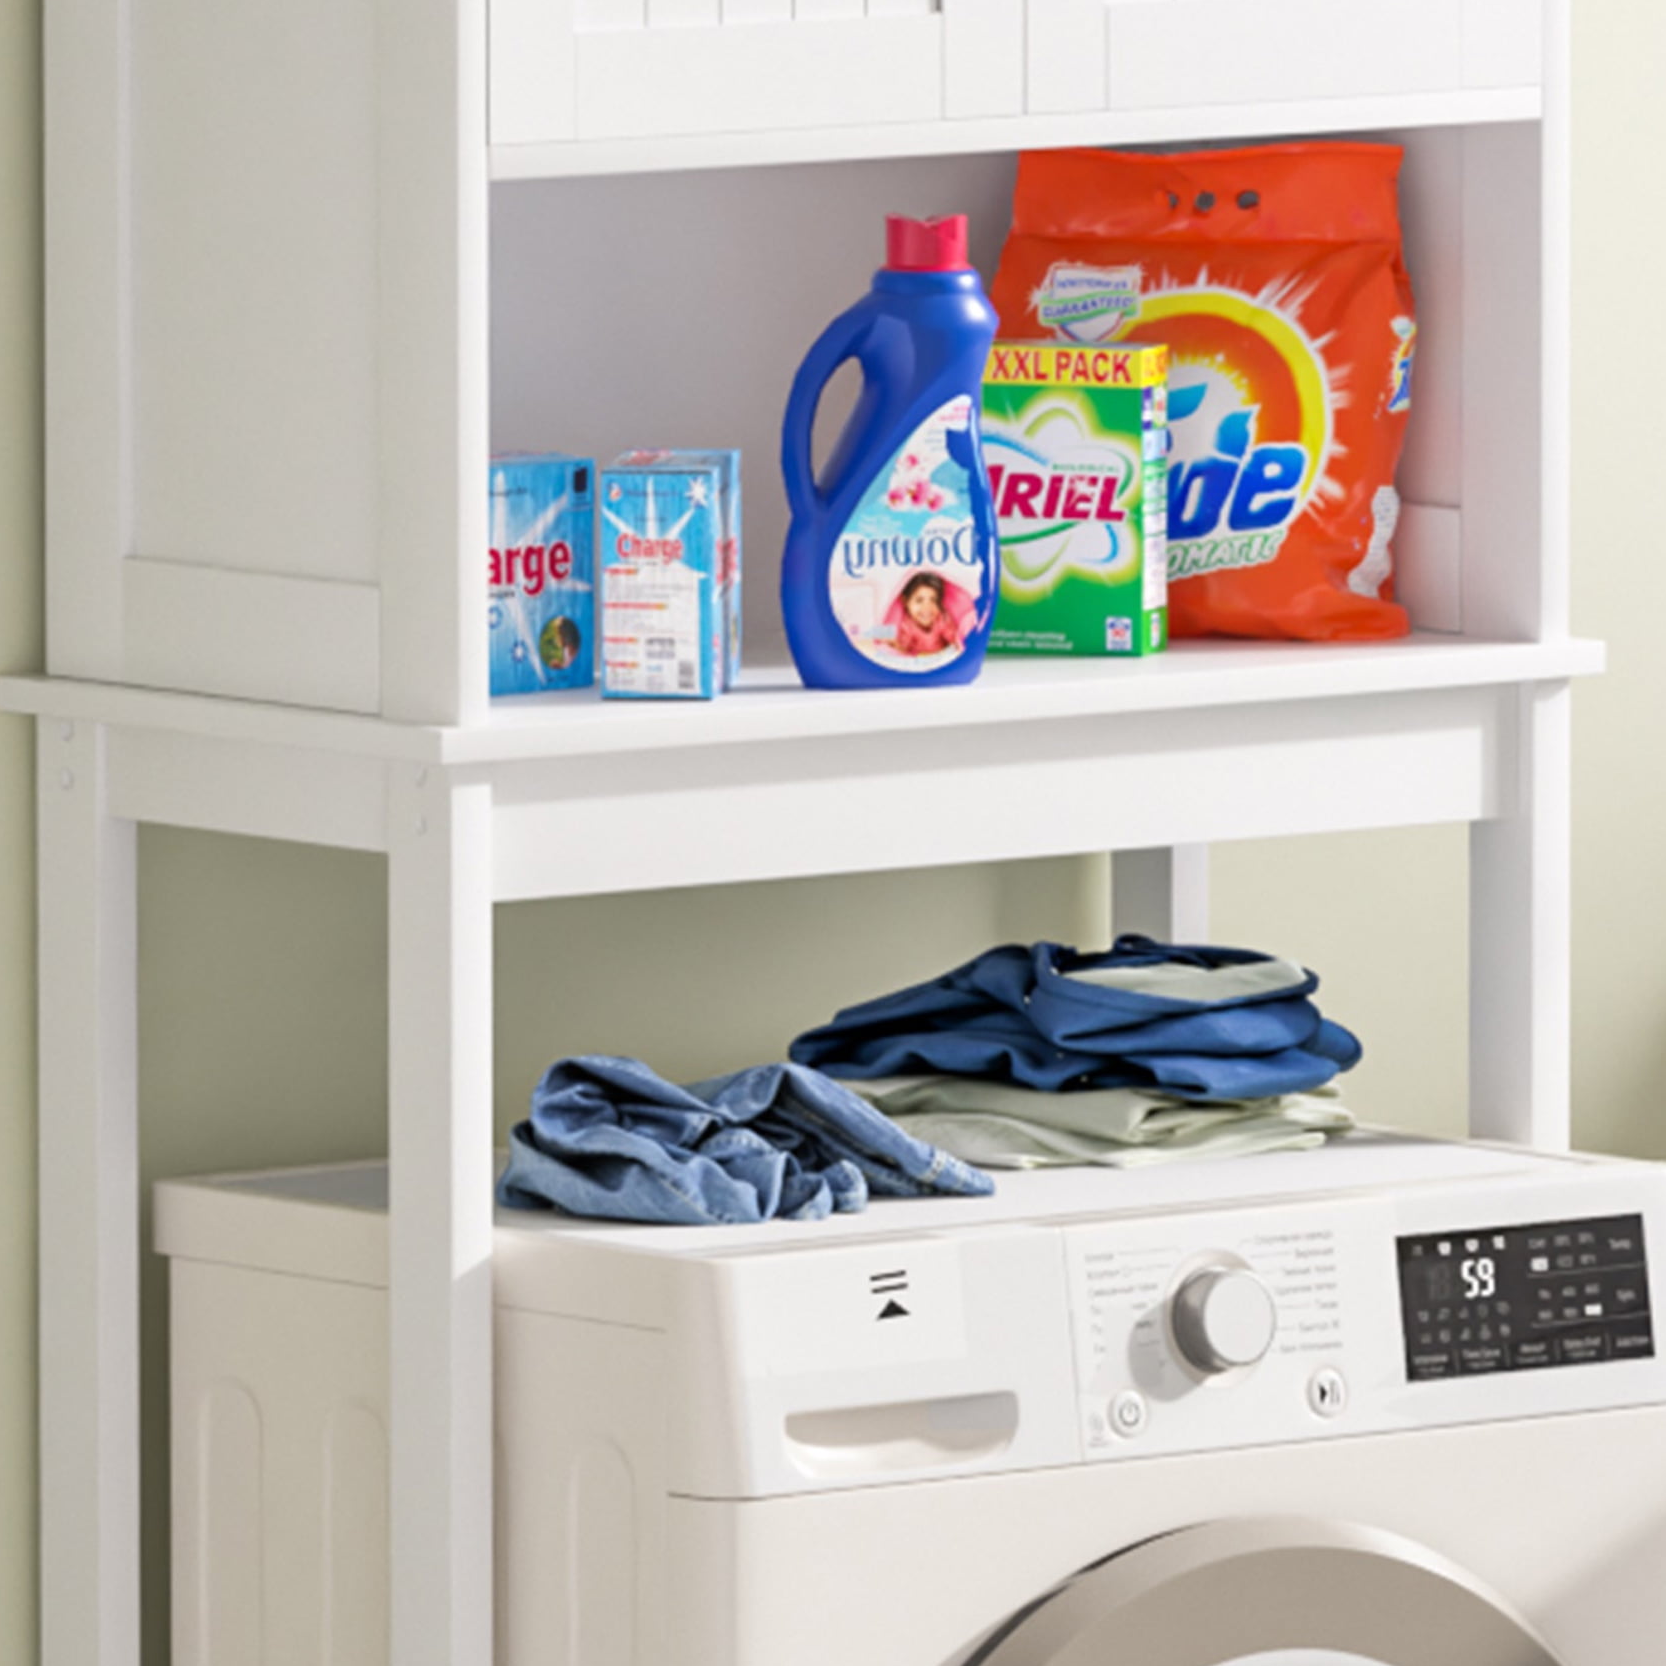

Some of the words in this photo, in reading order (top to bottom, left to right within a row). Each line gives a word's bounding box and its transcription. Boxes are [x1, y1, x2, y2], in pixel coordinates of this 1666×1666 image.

[992, 349, 1048, 381] XXL
[1054, 350, 1131, 384] PACK
[616, 533, 683, 566] Charge
[1460, 1257, 1496, 1299] 59
